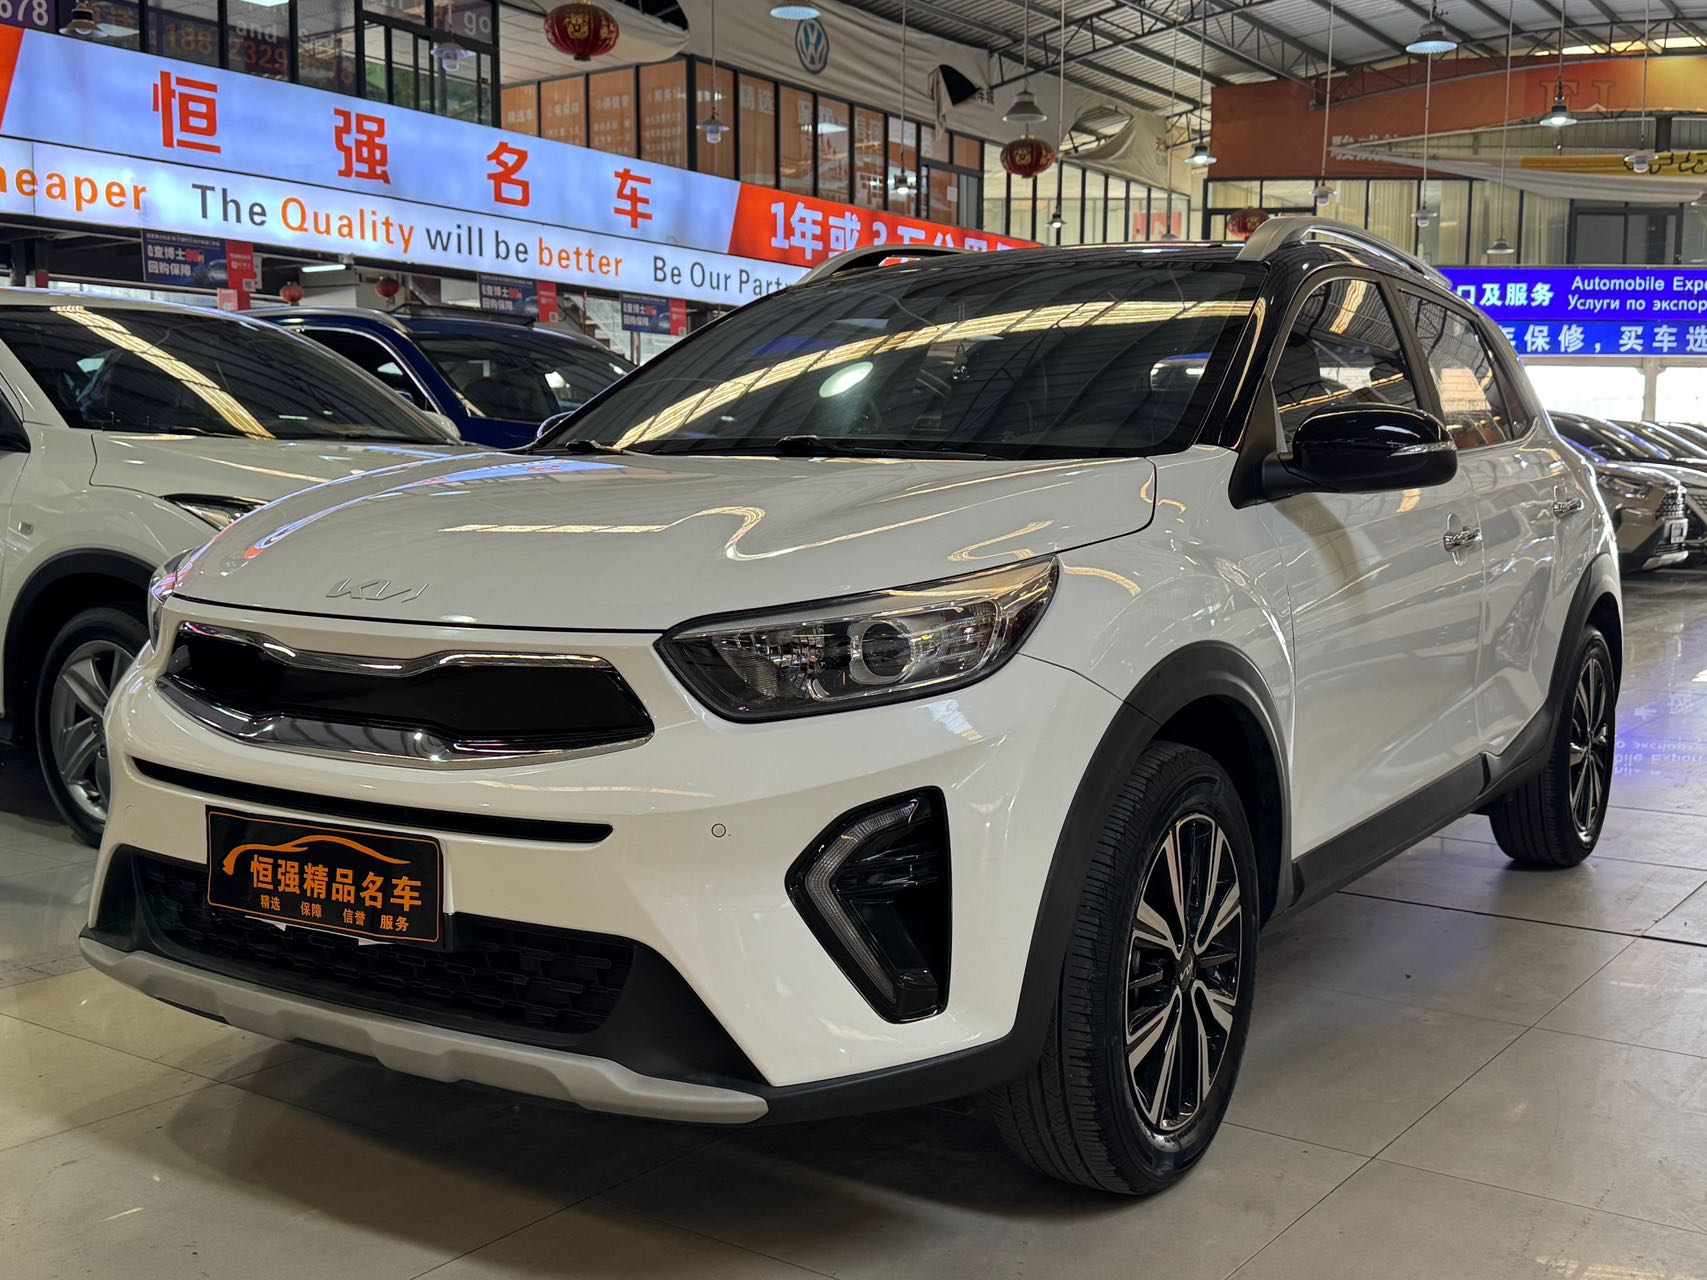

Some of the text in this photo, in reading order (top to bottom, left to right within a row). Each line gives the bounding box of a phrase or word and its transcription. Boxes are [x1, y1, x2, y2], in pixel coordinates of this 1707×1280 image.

[192, 183, 267, 226] The
[281, 197, 414, 254] Quality
[426, 224, 484, 257] will
[495, 230, 529, 263] be
[539, 236, 623, 277] better
[653, 256, 682, 285] Be
[690, 261, 731, 291] Our
[1571, 276, 1665, 292] Automobile
[1568, 294, 1707, 315] Услуги по экспор
[250, 854, 422, 911] 恒强精品名车
[260, 894, 409, 932] 精选 保障 信誉 服务
